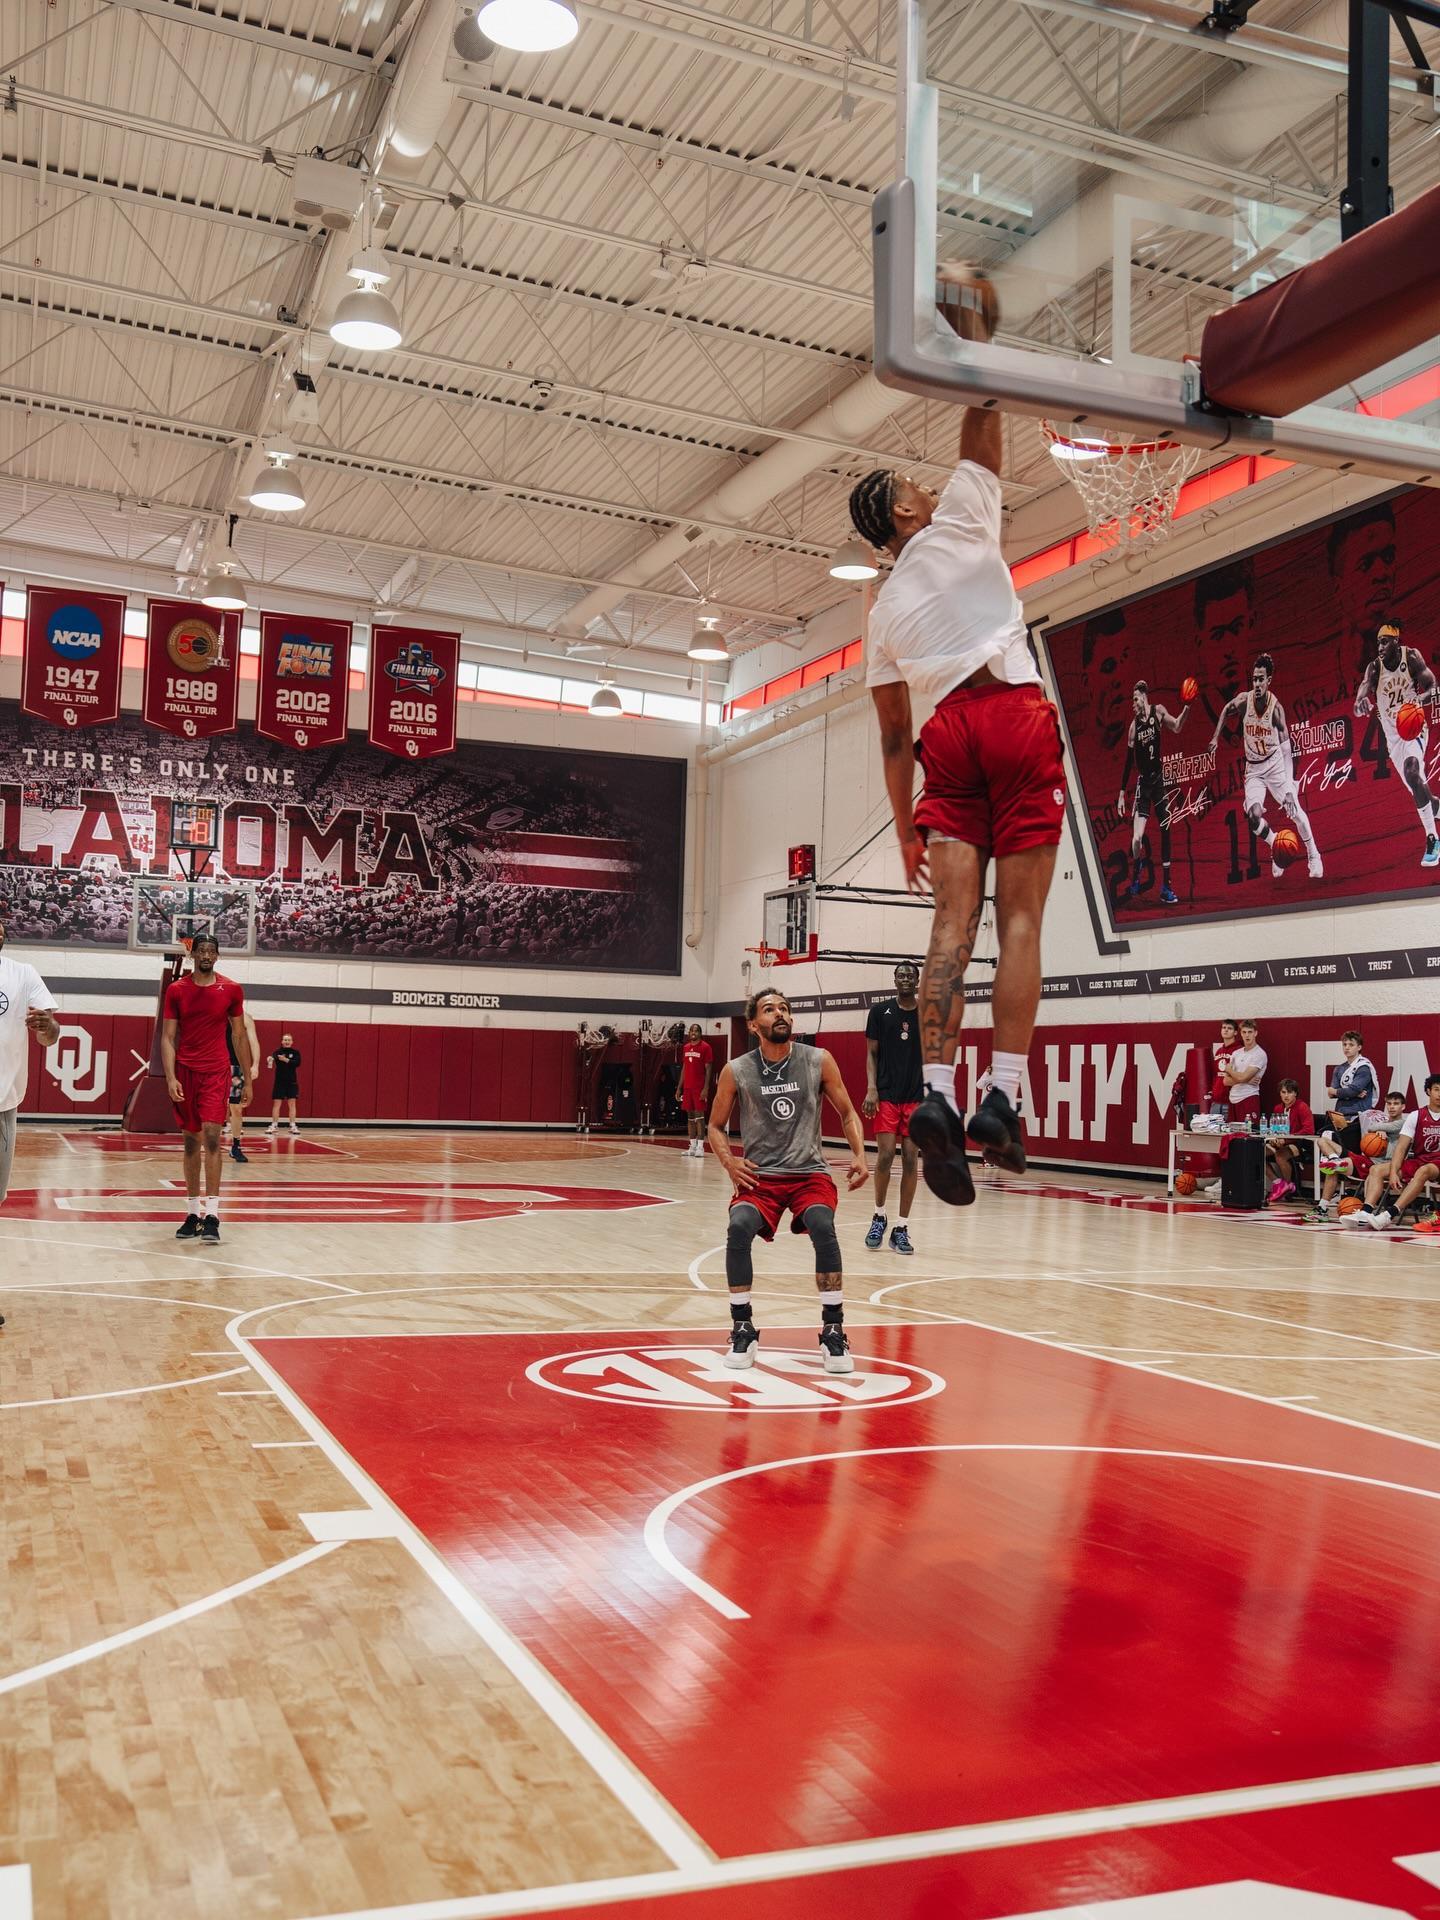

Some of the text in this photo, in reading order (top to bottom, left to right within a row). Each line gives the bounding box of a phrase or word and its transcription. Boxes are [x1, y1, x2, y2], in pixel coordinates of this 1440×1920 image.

[52, 629, 101, 649] NCAA
[279, 643, 332, 662] FINAL
[277, 657, 333, 677] FOUR
[390, 662, 440, 678] FINAL FOUR
[45, 665, 99, 691] 1947
[166, 677, 217, 702] 1988
[44, 691, 99, 705] FINAL FOUR
[276, 689, 330, 713] 2002
[1388, 689, 1404, 709] 24
[164, 702, 217, 716] FINAL FOUR
[390, 700, 437, 723] 2016
[277, 713, 328, 726] FINAL FOUR
[1290, 720, 1310, 731] TRAE
[388, 723, 437, 736] FINAL FOUR
[1291, 720, 1345, 752] YOUNG
[1149, 744, 1154, 760] 2
[1254, 738, 1267, 757] 11
[1163, 752, 1183, 762] BLAKE
[22, 748, 296, 786] THERE'S ONLY ONE
[1162, 752, 1216, 781] GRIFFIN
[1284, 964, 1337, 976] 6 EYES, 6 ARMS
[1368, 960, 1393, 971] TRUST
[1089, 978, 1138, 989] CLOSE TO THE BODY
[1160, 974, 1206, 985] SPRINT TO HELP
[1230, 970, 1257, 981] SHADOW
[1043, 983, 1069, 992] TO THE RIM
[392, 991, 500, 1008] BOOMER SOONER
[760, 1081, 800, 1095] BASKETBALL
[777, 1100, 790, 1116] OU
